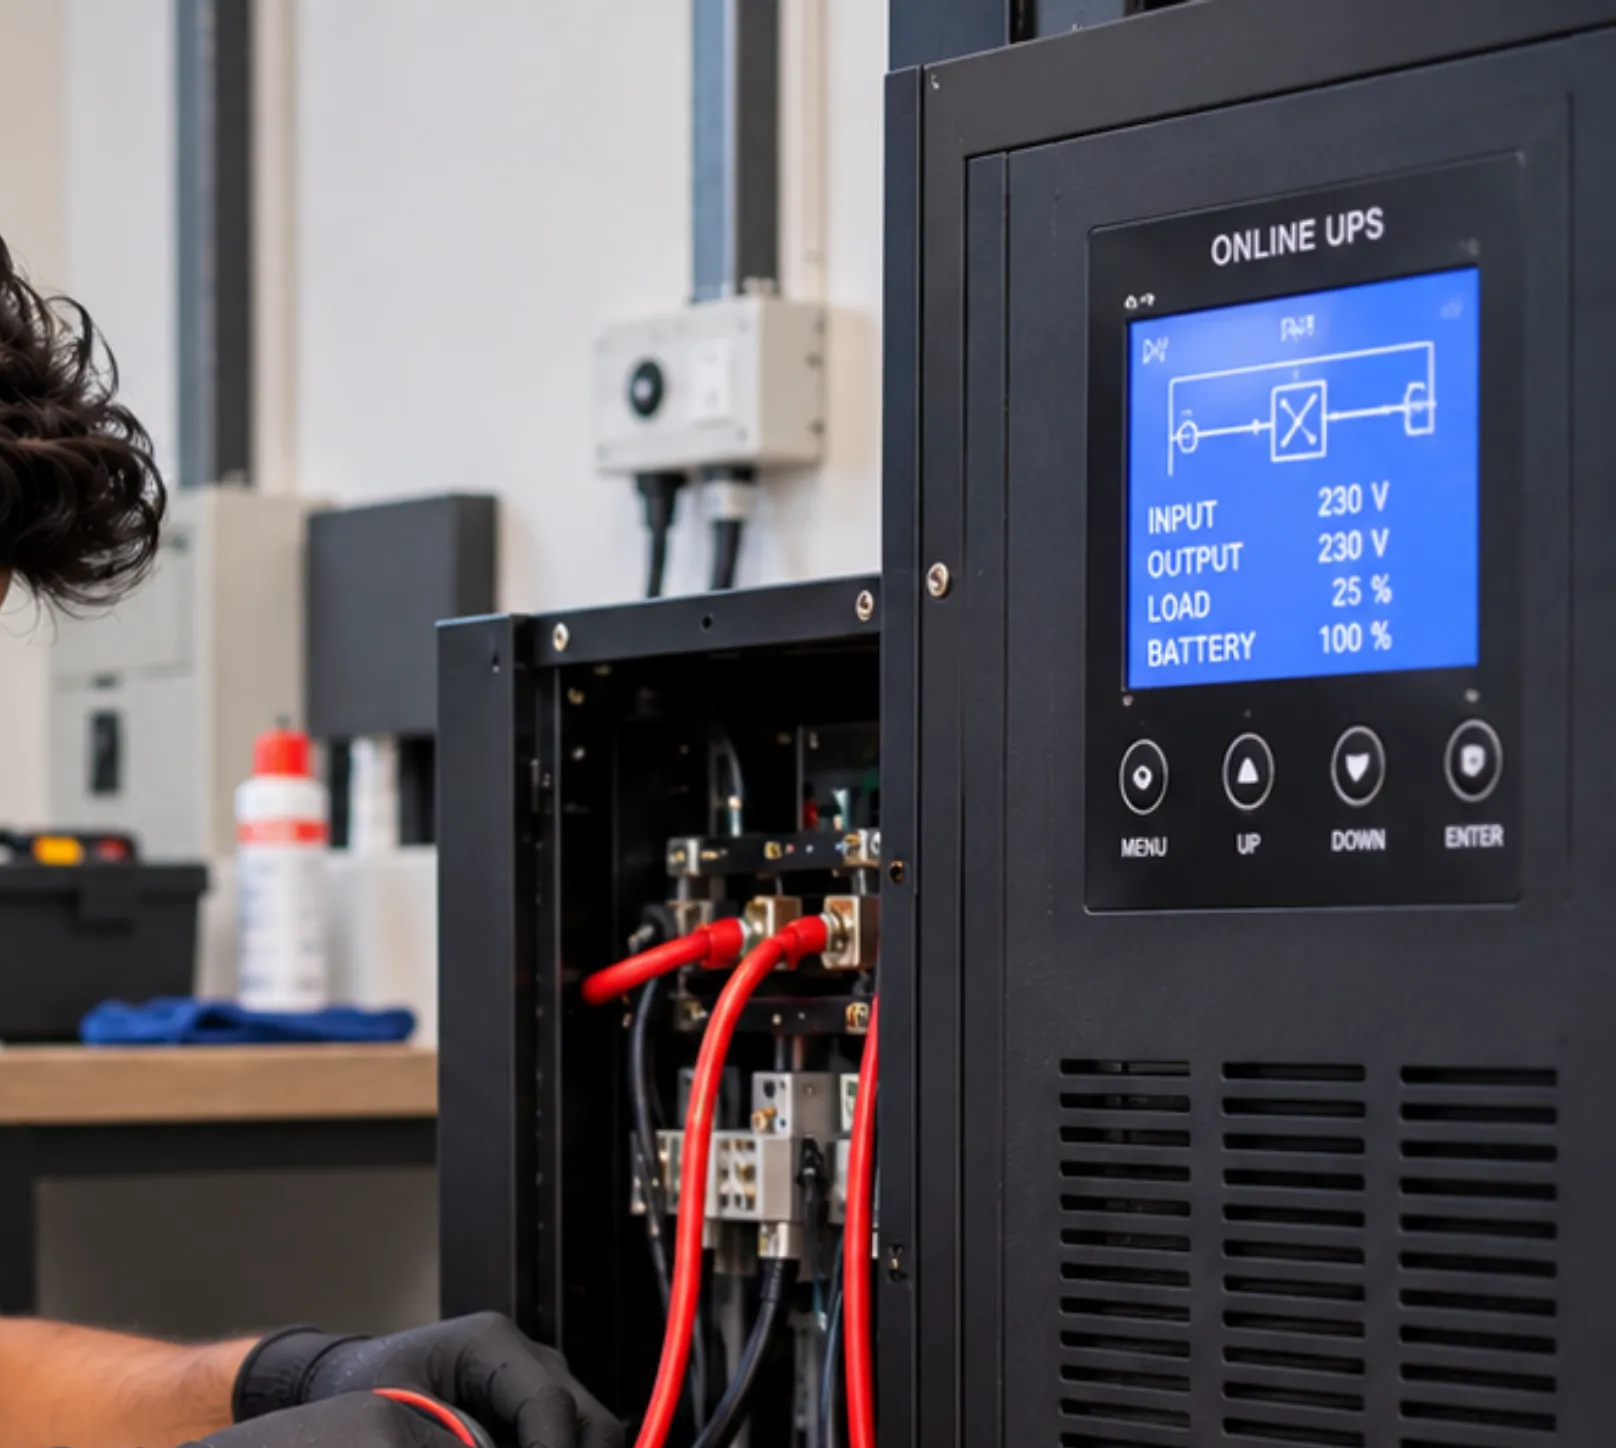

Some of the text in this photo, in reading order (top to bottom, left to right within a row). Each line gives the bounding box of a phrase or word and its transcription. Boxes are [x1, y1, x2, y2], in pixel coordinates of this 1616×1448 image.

[1210, 206, 1384, 266] ONLINE UPS
[1148, 480, 1390, 535] INPUT 230 V
[1147, 527, 1390, 579] OUTPUT 230 V
[1147, 573, 1393, 623] LOAD 25 %
[1147, 619, 1393, 668] BATTERY 100 %
[1121, 836, 1168, 858] MENU
[1237, 832, 1262, 855] UP
[1331, 828, 1386, 852] DOWN
[1444, 823, 1504, 849] ENTER
